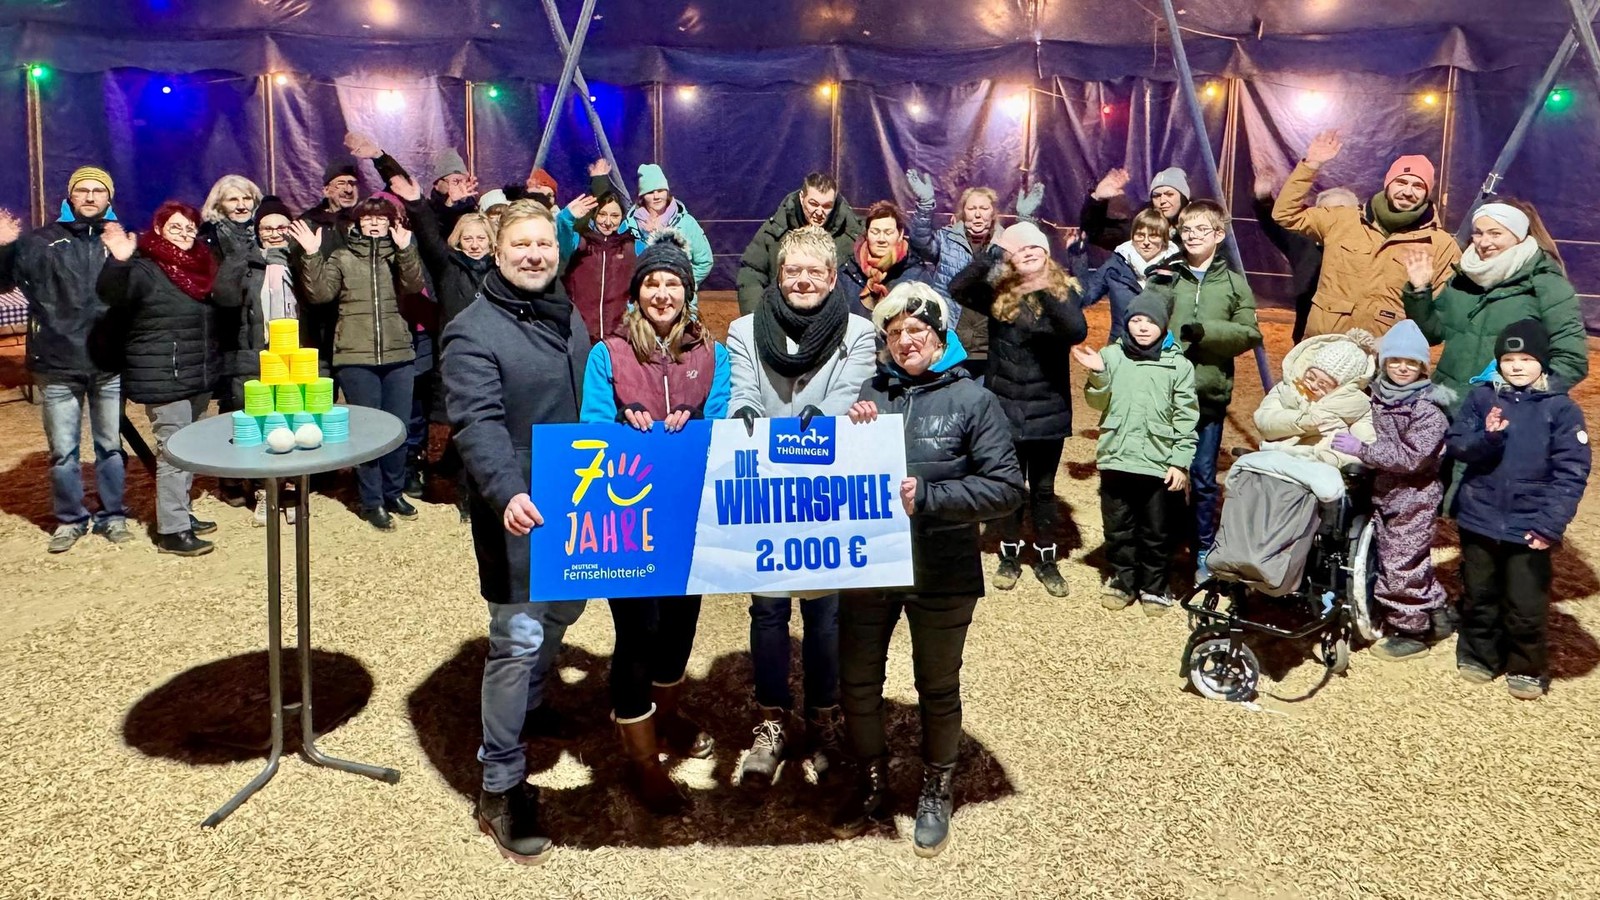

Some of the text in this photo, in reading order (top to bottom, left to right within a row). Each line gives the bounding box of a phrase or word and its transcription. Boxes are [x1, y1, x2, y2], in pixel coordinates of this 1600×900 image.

[776, 428, 829, 446] mdr
[776, 446, 829, 457] THÜRINGEN
[734, 449, 759, 478] DIE
[715, 473, 893, 525] WINTERSPIELE
[564, 507, 654, 556] JAHRE
[756, 536, 868, 572] 2.000 €
[563, 566, 647, 580] Fernsehlotterie
[571, 563, 599, 571] DEUTSCHE
